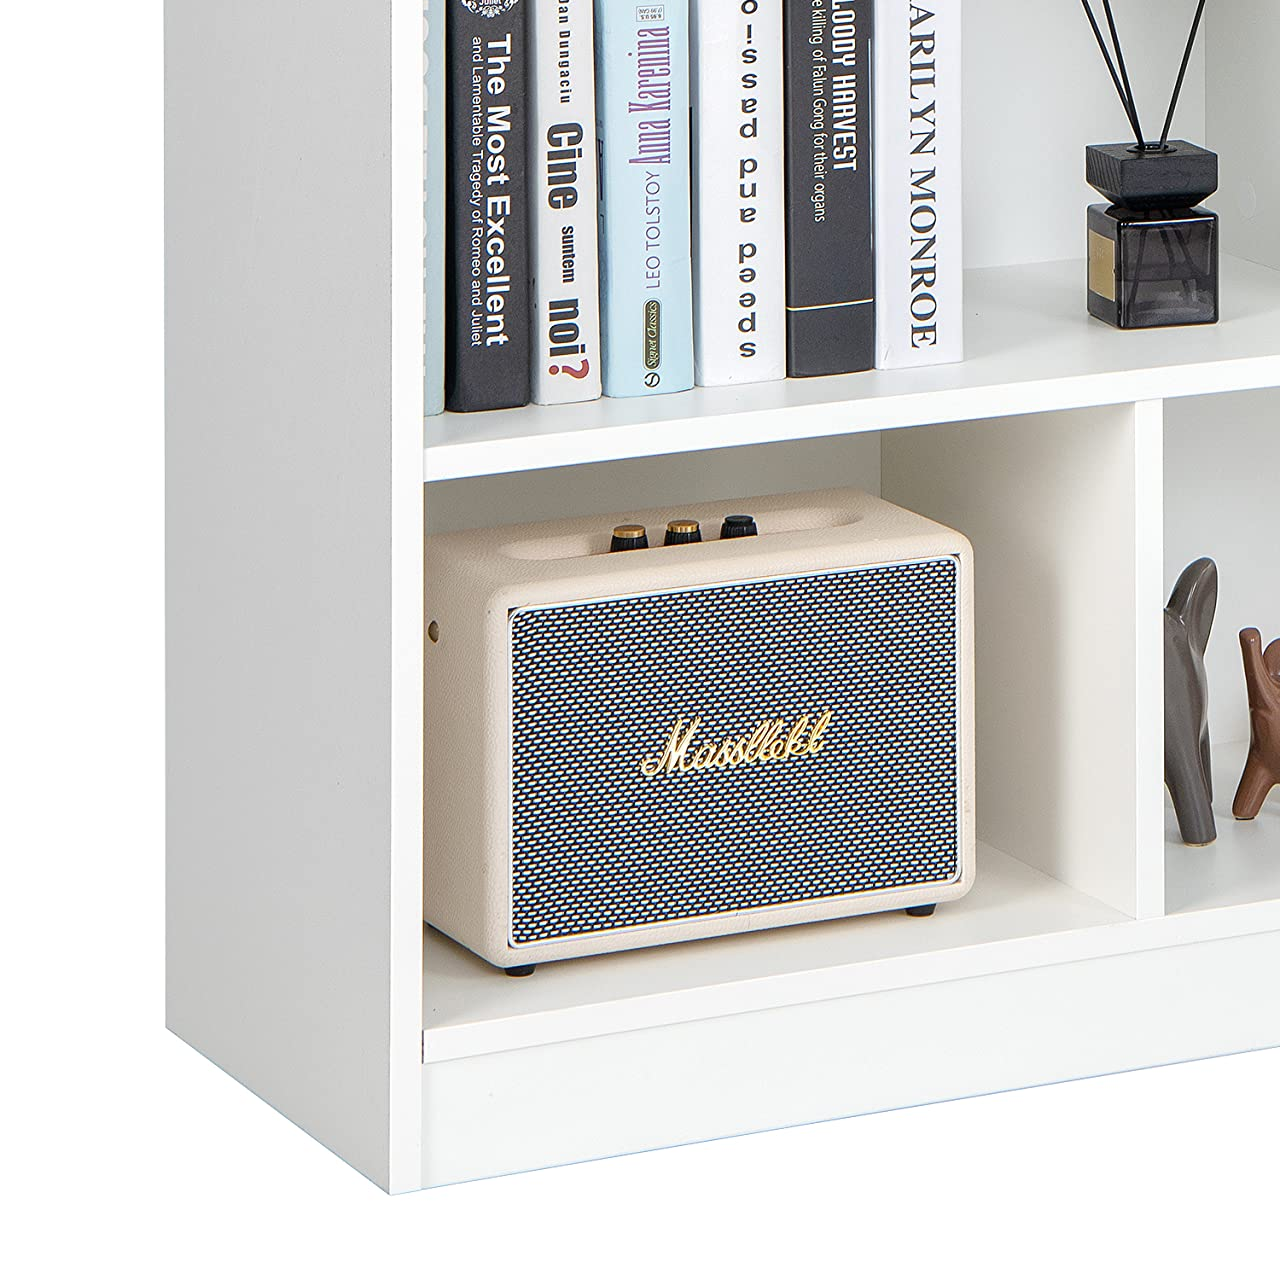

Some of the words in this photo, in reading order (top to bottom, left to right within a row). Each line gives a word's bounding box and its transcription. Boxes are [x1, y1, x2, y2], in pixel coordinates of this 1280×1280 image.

[472, 37, 484, 62] and
[809, 8, 827, 45] killing
[487, 33, 511, 95] The
[558, 32, 573, 104] Dungaciu
[628, 26, 671, 113] Karenina
[812, 49, 826, 62] of
[812, 65, 827, 96] Falun
[471, 66, 484, 146] Lamentable
[810, 98, 827, 129] Gong
[832, 75, 856, 171] HARVEST
[487, 105, 511, 186] Most
[546, 122, 584, 210] Cine
[628, 119, 671, 164] Anna
[813, 133, 827, 149] for
[813, 153, 828, 179] their
[469, 150, 484, 207] Tragedy
[739, 158, 758, 223] and
[811, 183, 825, 222] organs
[471, 210, 483, 225] of
[645, 171, 661, 251] TOLSTOY
[471, 228, 484, 277] Romeo
[486, 195, 511, 347] Excellent
[561, 226, 576, 283] suntem
[645, 256, 661, 288] LEO
[910, 166, 938, 349] MONROE
[471, 281, 483, 307] and
[738, 243, 757, 358] speed
[471, 310, 483, 347] Juliet
